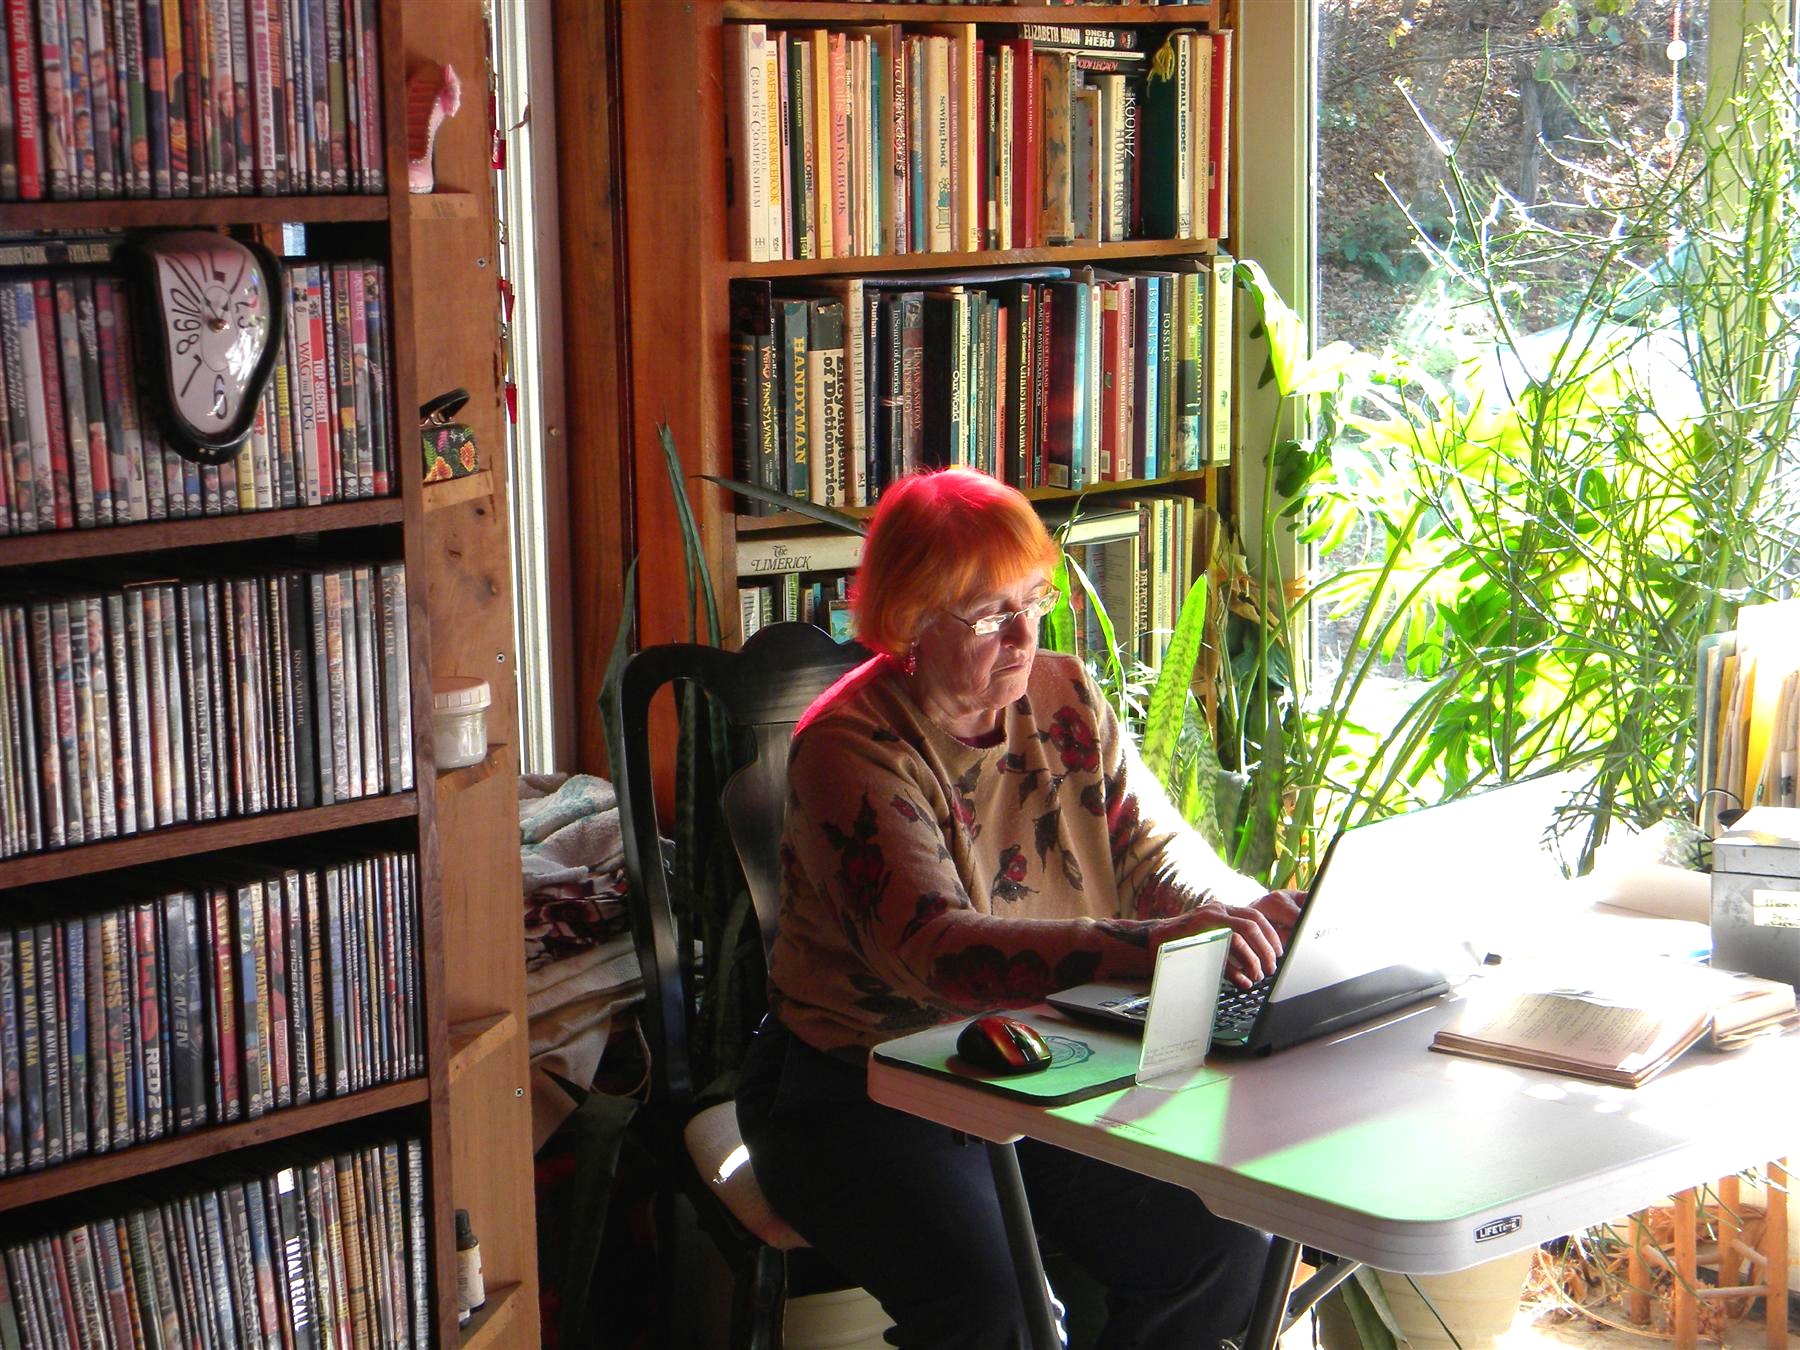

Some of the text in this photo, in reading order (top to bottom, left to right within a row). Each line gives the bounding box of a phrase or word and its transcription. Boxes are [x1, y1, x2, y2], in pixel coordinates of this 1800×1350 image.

[1023, 24, 1081, 45] ELIZABETH MOON
[1085, 29, 1115, 40] ONCE A
[1085, 38, 1115, 49] HERO
[14, 10, 34, 139] LOVE YOU TO DEATH
[1180, 53, 1188, 107] FOOTBALL
[260, 73, 272, 166] MOVIE PACK
[750, 66, 763, 209] CRAFTS COMPENDIUM
[767, 61, 780, 203] CRAFTS SUPPLY SOURCEBOOK
[893, 57, 905, 171] VICTORIAN CRAFTS
[938, 96, 949, 169] sewing book
[1125, 96, 1137, 159] KOONTZ
[1180, 110, 1188, 153] HEROES
[837, 114, 845, 172] SEWING
[1114, 128, 1125, 177] HOME
[838, 174, 847, 216] BOOK
[1113, 181, 1125, 229] FRONT
[870, 301, 879, 338] Durham
[1120, 287, 1128, 315] National
[1148, 287, 1159, 356] BONES
[176, 333, 200, 355] 8
[300, 341, 311, 376] WAG
[893, 318, 901, 348] Search
[893, 349, 900, 358] of
[1119, 316, 1127, 350] Geographic
[1162, 312, 1171, 363] FOSSILS
[1217, 295, 1227, 379] MYTHOLOGY
[313, 360, 329, 423] TOP SECRET!
[793, 336, 806, 465] HANDYMAN
[853, 333, 864, 416] HOMEOPATHY
[893, 358, 901, 394] America
[903, 358, 914, 415] PHYSIOLOGY
[912, 347, 923, 431] HUMAN ANATOMY
[951, 370, 960, 391] Our
[1019, 365, 1027, 425] CHRISTMAS
[302, 394, 315, 430] DOG
[822, 356, 837, 506] of Dictionaries
[951, 391, 960, 423] World
[1119, 402, 1127, 433] HISTORY
[751, 556, 813, 572] LIMERICK
[771, 544, 789, 558] The
[383, 578, 396, 656] EXCALIBUR
[1139, 568, 1148, 632] DRACULA
[314, 621, 325, 657] TITANS
[293, 649, 306, 727] KING ARTHUR
[195, 678, 211, 783] ROBIN HOOD
[0, 939, 20, 1068] HANCOCK
[289, 939, 301, 1028] SPIDER-MAN
[173, 972, 189, 1050] X-MEN
[144, 1047, 163, 1109] RED 2
[384, 1152, 398, 1189] JOHN
[285, 1235, 304, 1279] TOTAL
[236, 1235, 256, 1344] SALVATION
[290, 1278, 310, 1331] RECALL
